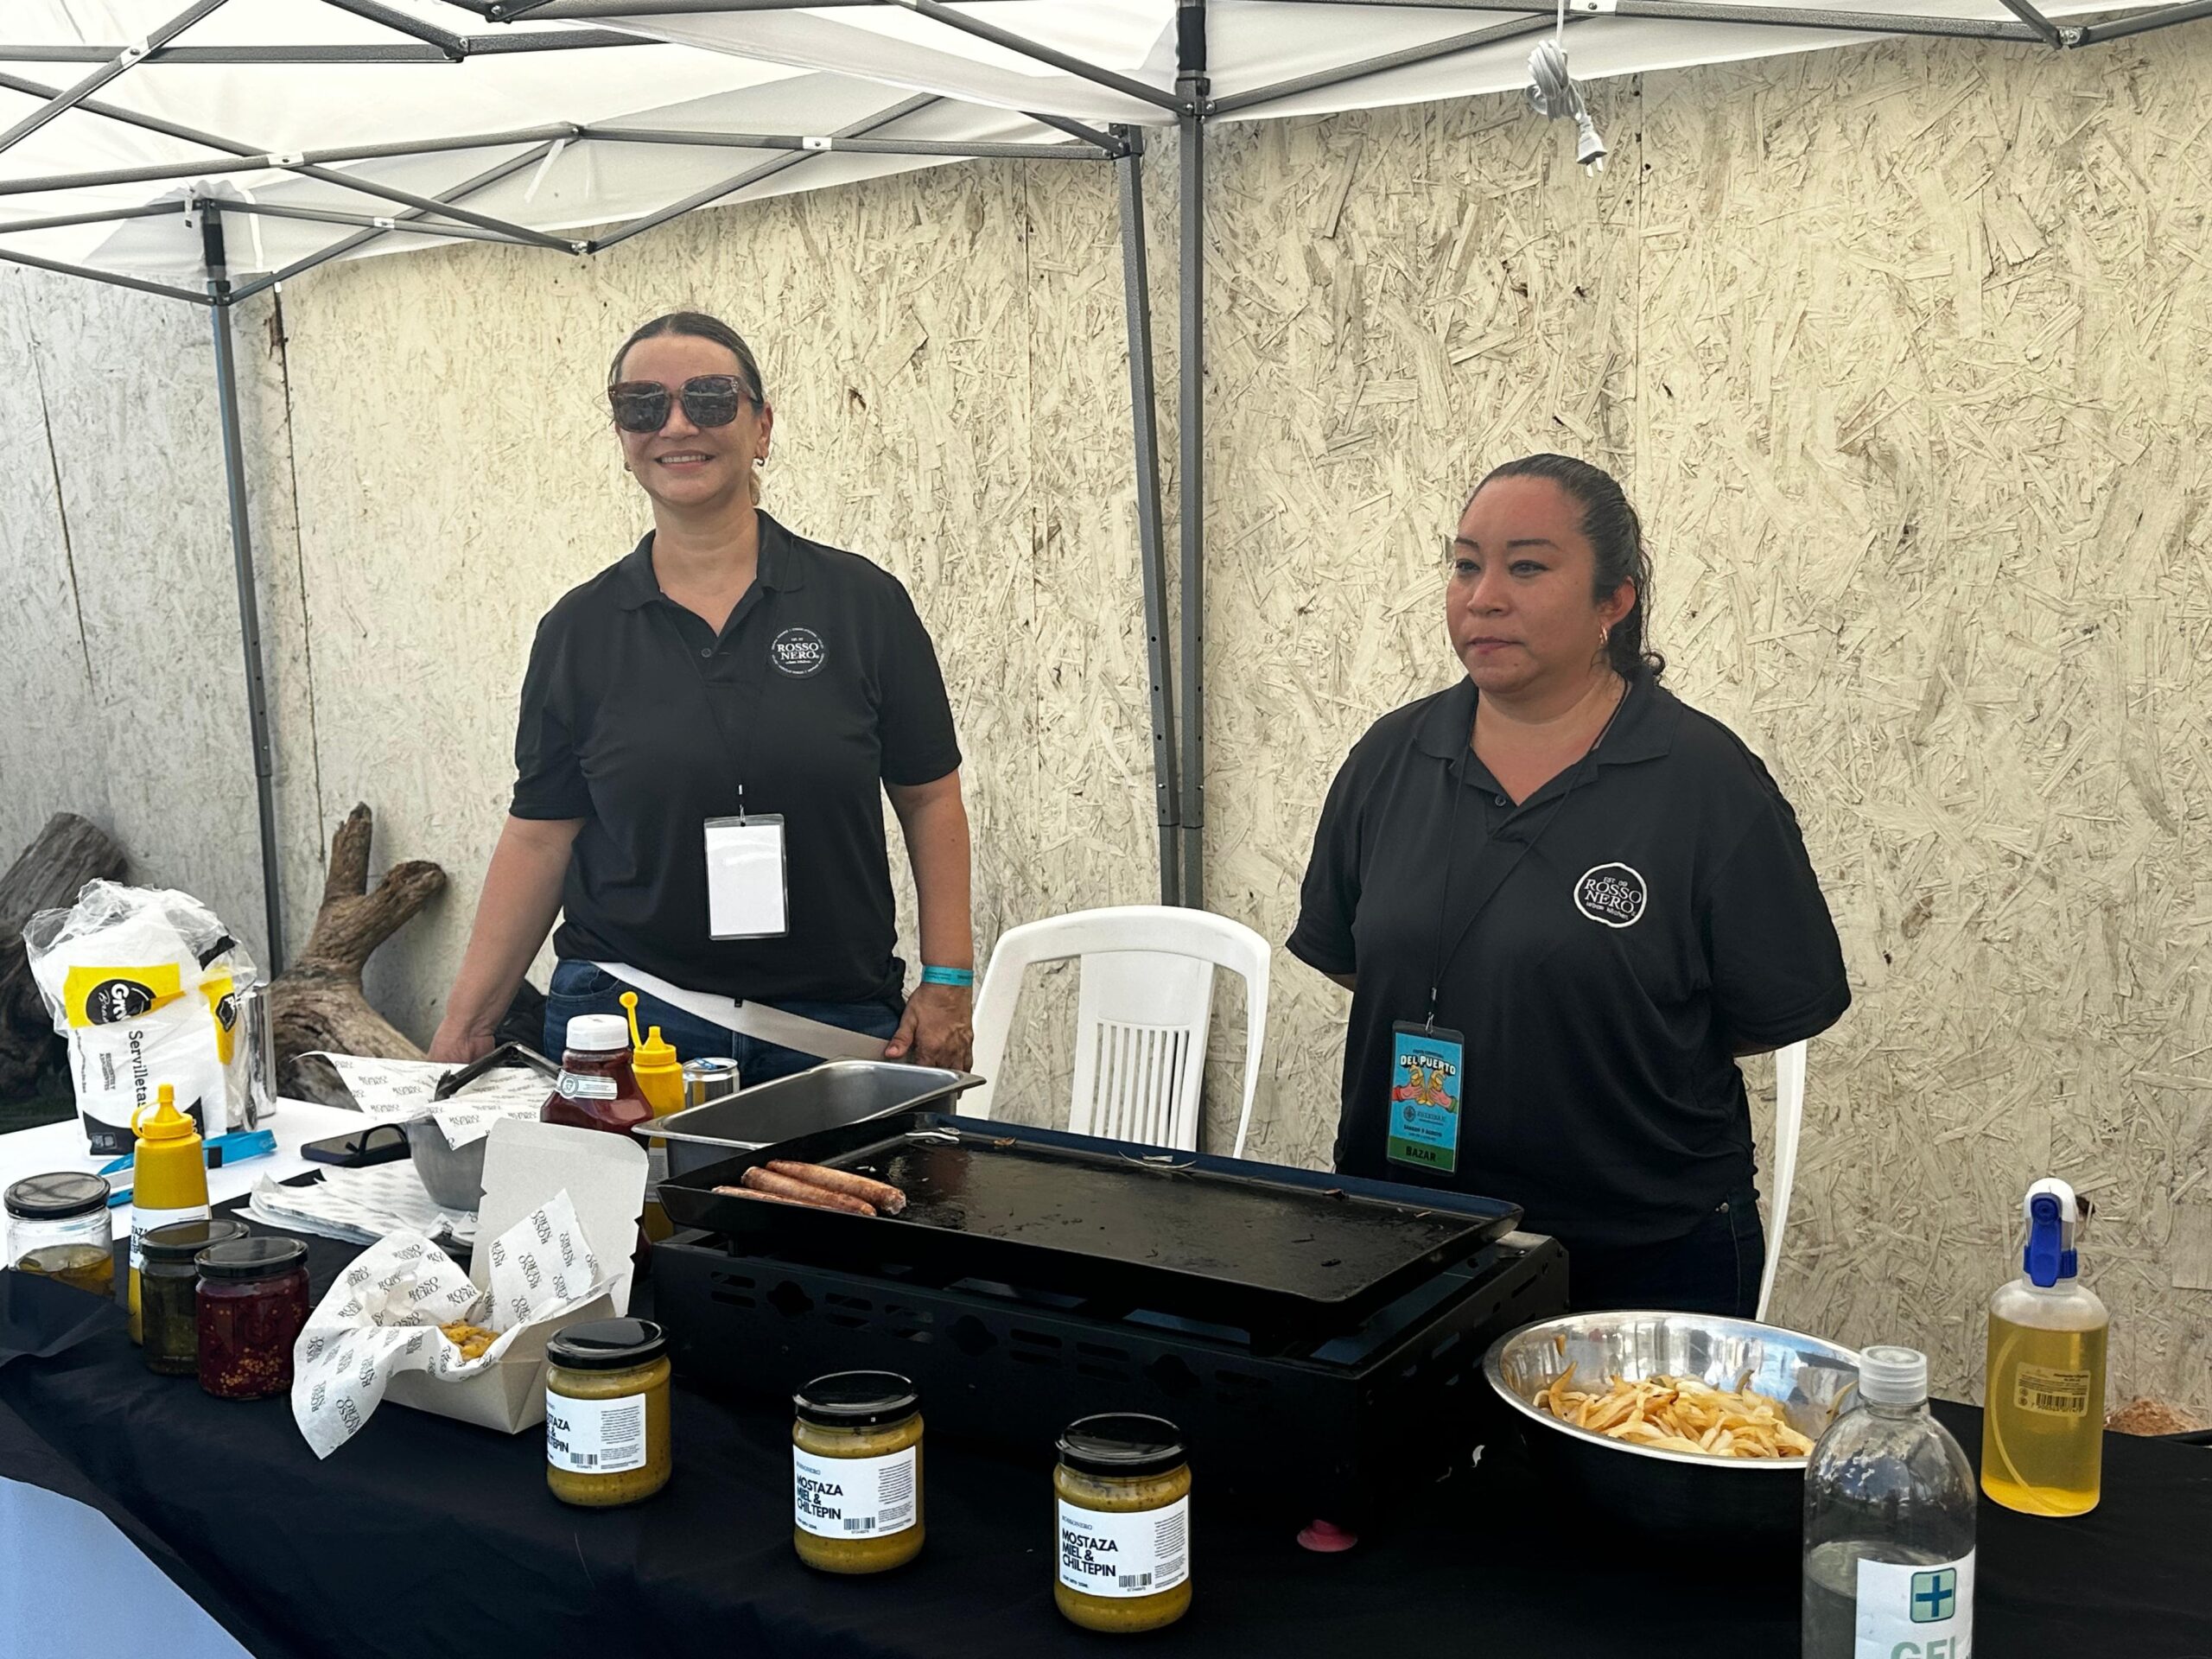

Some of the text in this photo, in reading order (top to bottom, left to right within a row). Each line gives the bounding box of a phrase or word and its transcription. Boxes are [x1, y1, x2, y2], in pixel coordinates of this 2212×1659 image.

[777, 642, 819, 652] ROSSO
[781, 651, 816, 660] NERO
[1584, 878, 1642, 904] ROSSO
[1585, 890, 1634, 913] NERO
[1400, 1055, 1456, 1075] DEL PUERTO
[1406, 1146, 1436, 1162] BAZAR
[797, 1473, 843, 1497] MOSTAZA
[797, 1484, 822, 1505] MIEL &
[797, 1497, 841, 1520] CHILTEPIN
[1062, 1527, 1118, 1552] MOSTAZA
[1062, 1542, 1094, 1562] MIEL &
[1062, 1554, 1116, 1577] CHILTEPIN
